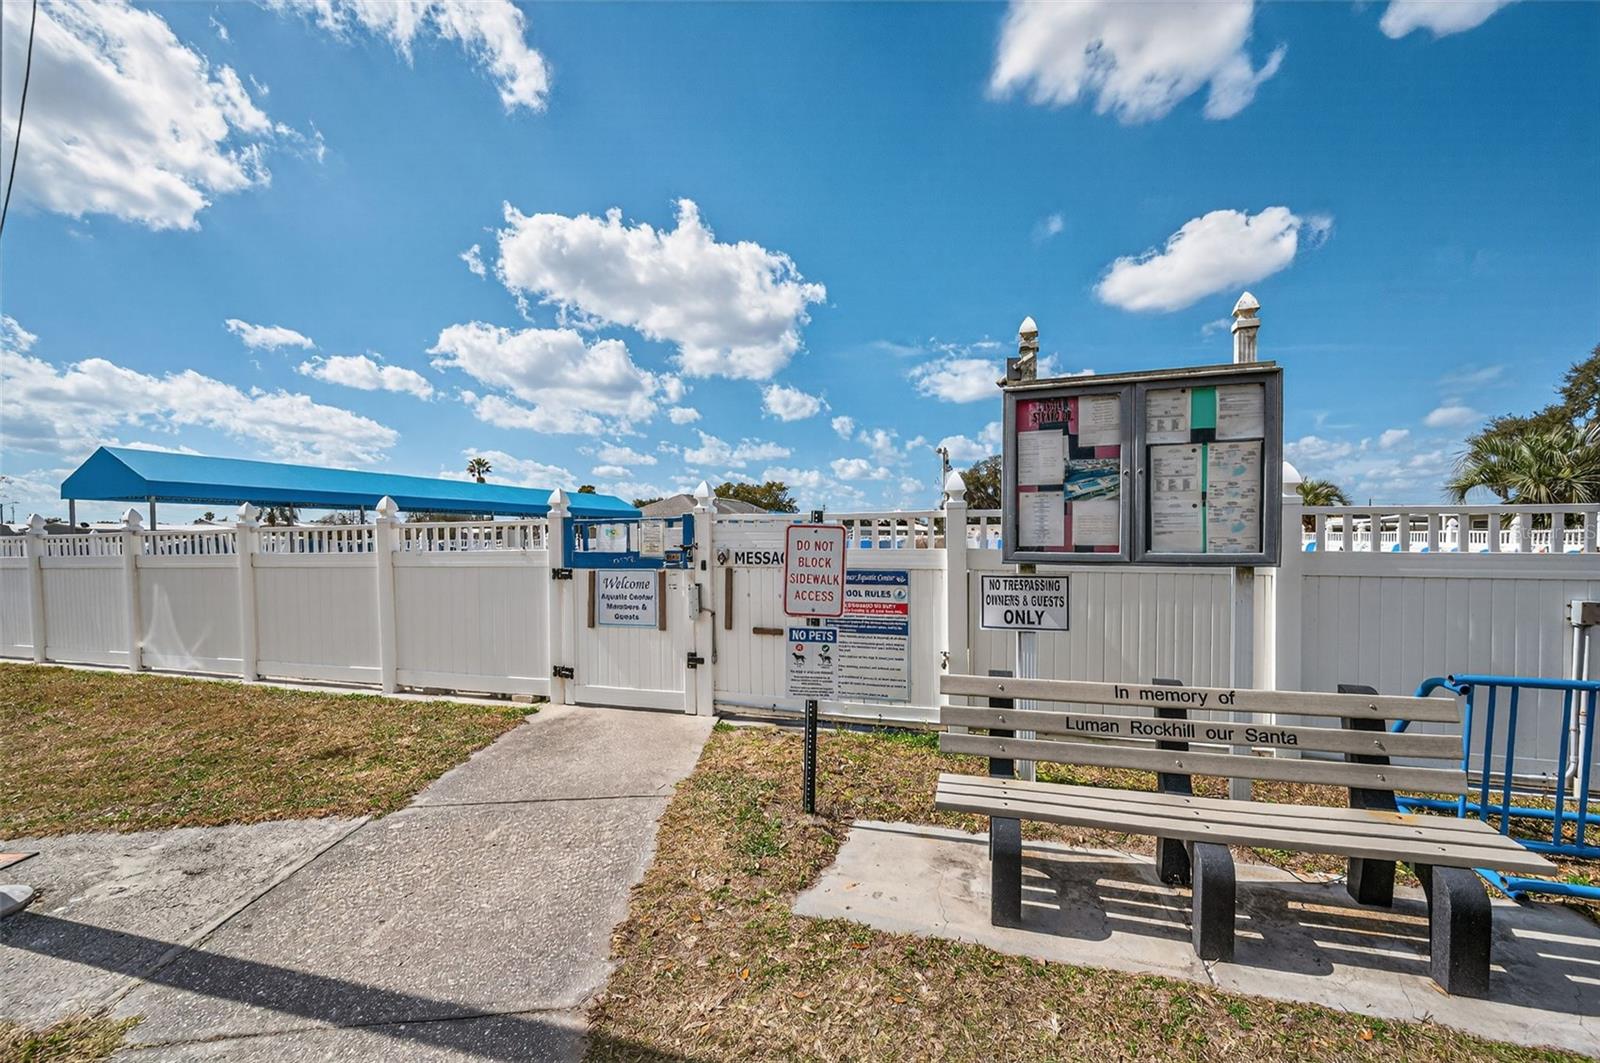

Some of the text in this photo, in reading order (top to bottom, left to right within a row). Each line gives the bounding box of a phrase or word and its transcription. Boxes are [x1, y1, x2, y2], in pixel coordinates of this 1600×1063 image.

[796, 540, 834, 552] DO NOT
[798, 557, 832, 568] BLOCK
[602, 575, 650, 590] Welcome
[789, 573, 840, 586] SIDEWALK
[989, 579, 1060, 592] NO TRESPASSING
[601, 593, 654, 602] Aquatic Center
[794, 590, 834, 602] ACCESS
[846, 589, 891, 598] OOL RULES
[606, 603, 640, 611] Members
[986, 594, 1065, 608] OWNERS & GUESTS
[614, 613, 640, 621] Guests
[1004, 609, 1046, 625] ONLY
[792, 630, 807, 640] NO
[808, 630, 833, 641] PETS
[1114, 684, 1236, 707] In memory of
[1065, 716, 1298, 745] Luman Rockhill our Santa
